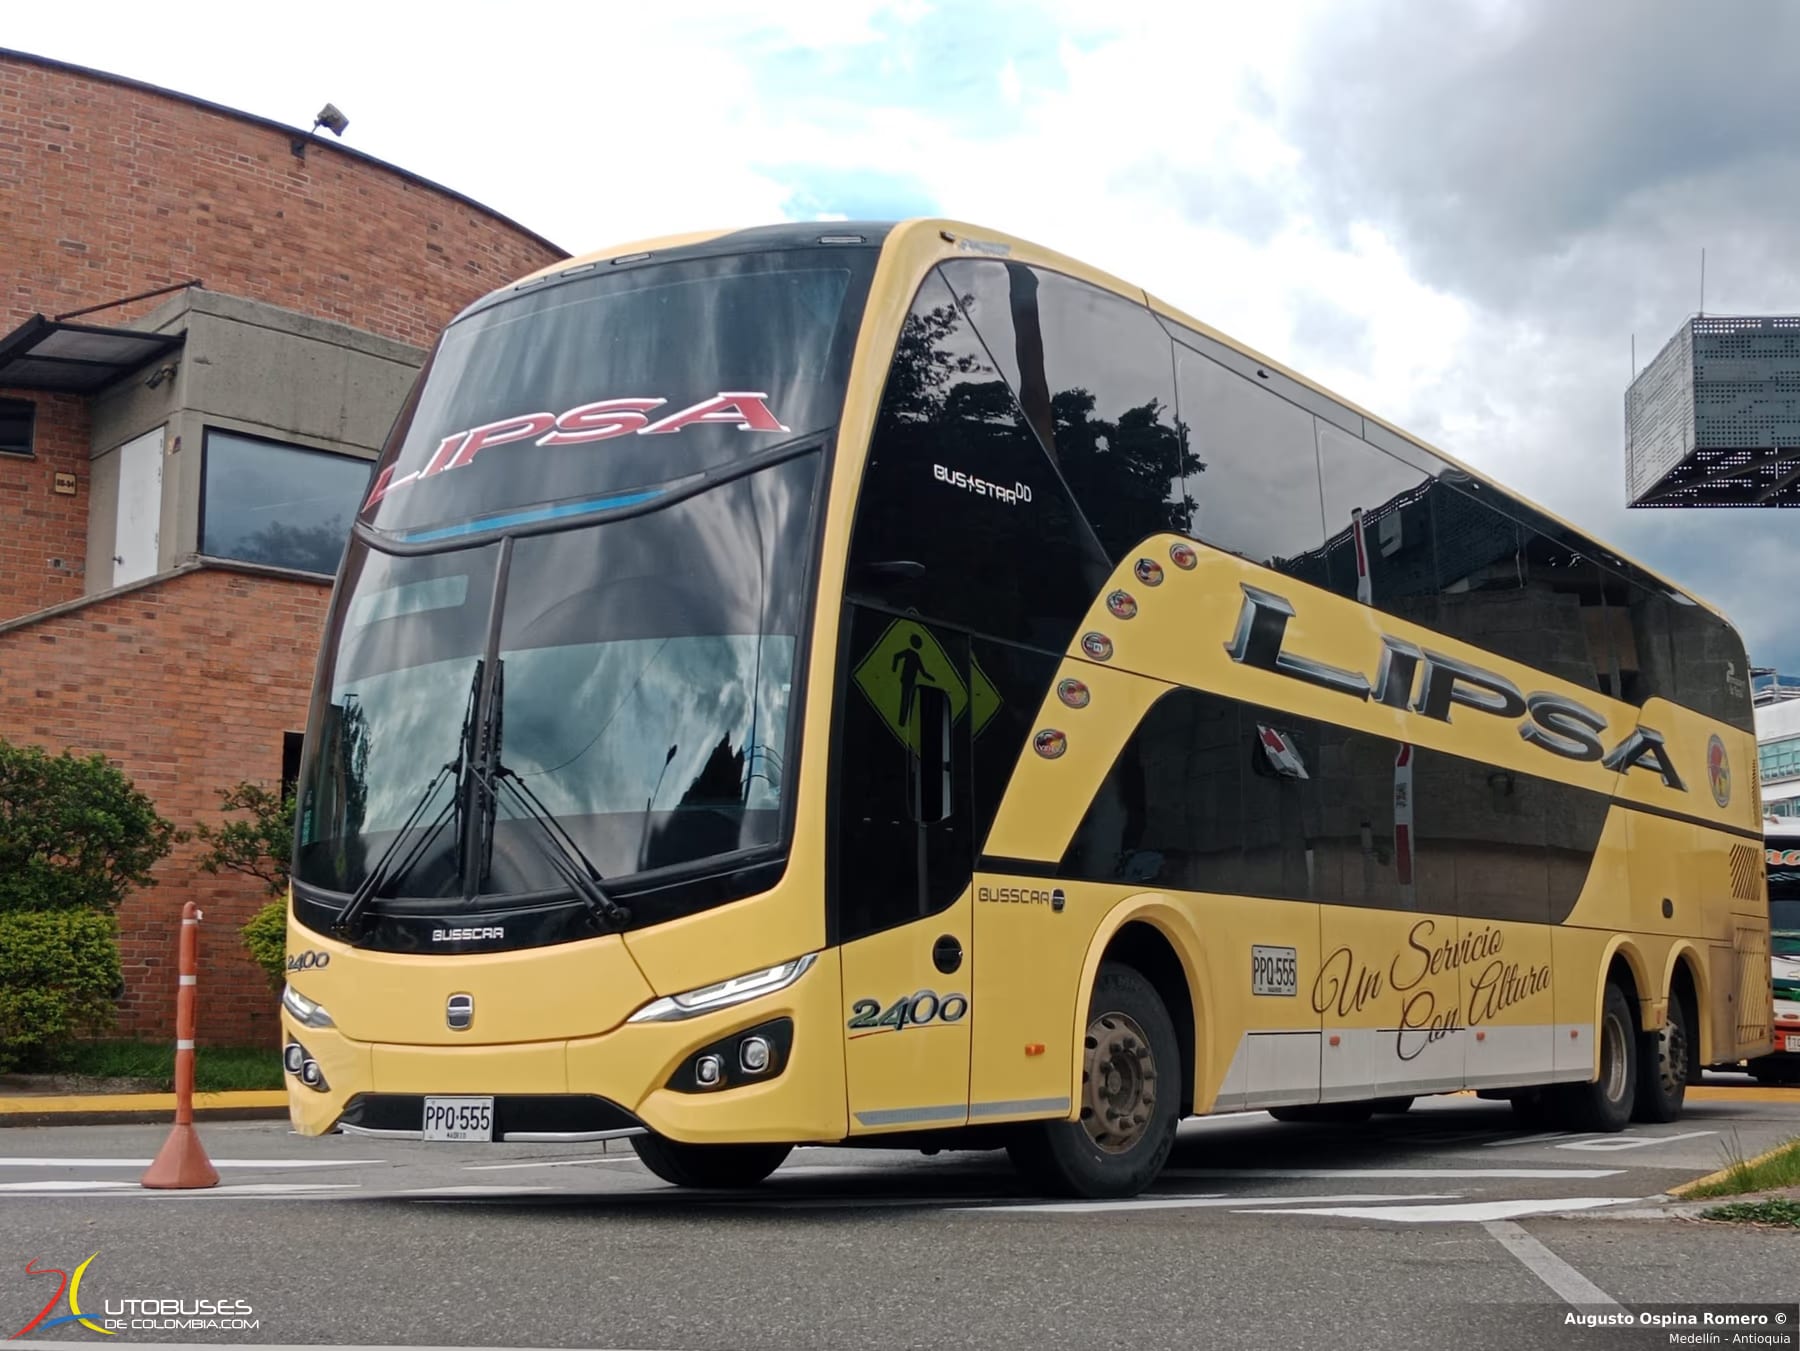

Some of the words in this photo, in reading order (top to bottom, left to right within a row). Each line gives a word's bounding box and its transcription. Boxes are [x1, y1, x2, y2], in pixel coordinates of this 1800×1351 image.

[361, 391, 791, 514] LIPSA
[1223, 582, 1689, 793] LIPSA
[978, 887, 1050, 907] BUSSCAR
[287, 950, 330, 972] 2400
[432, 927, 504, 942] BUSSCAR
[1311, 947, 1383, 1018] Un
[1389, 919, 1504, 992] Servicio
[848, 990, 968, 1031] 2400
[1396, 990, 1460, 1061] Con
[1467, 960, 1551, 1027] Altura
